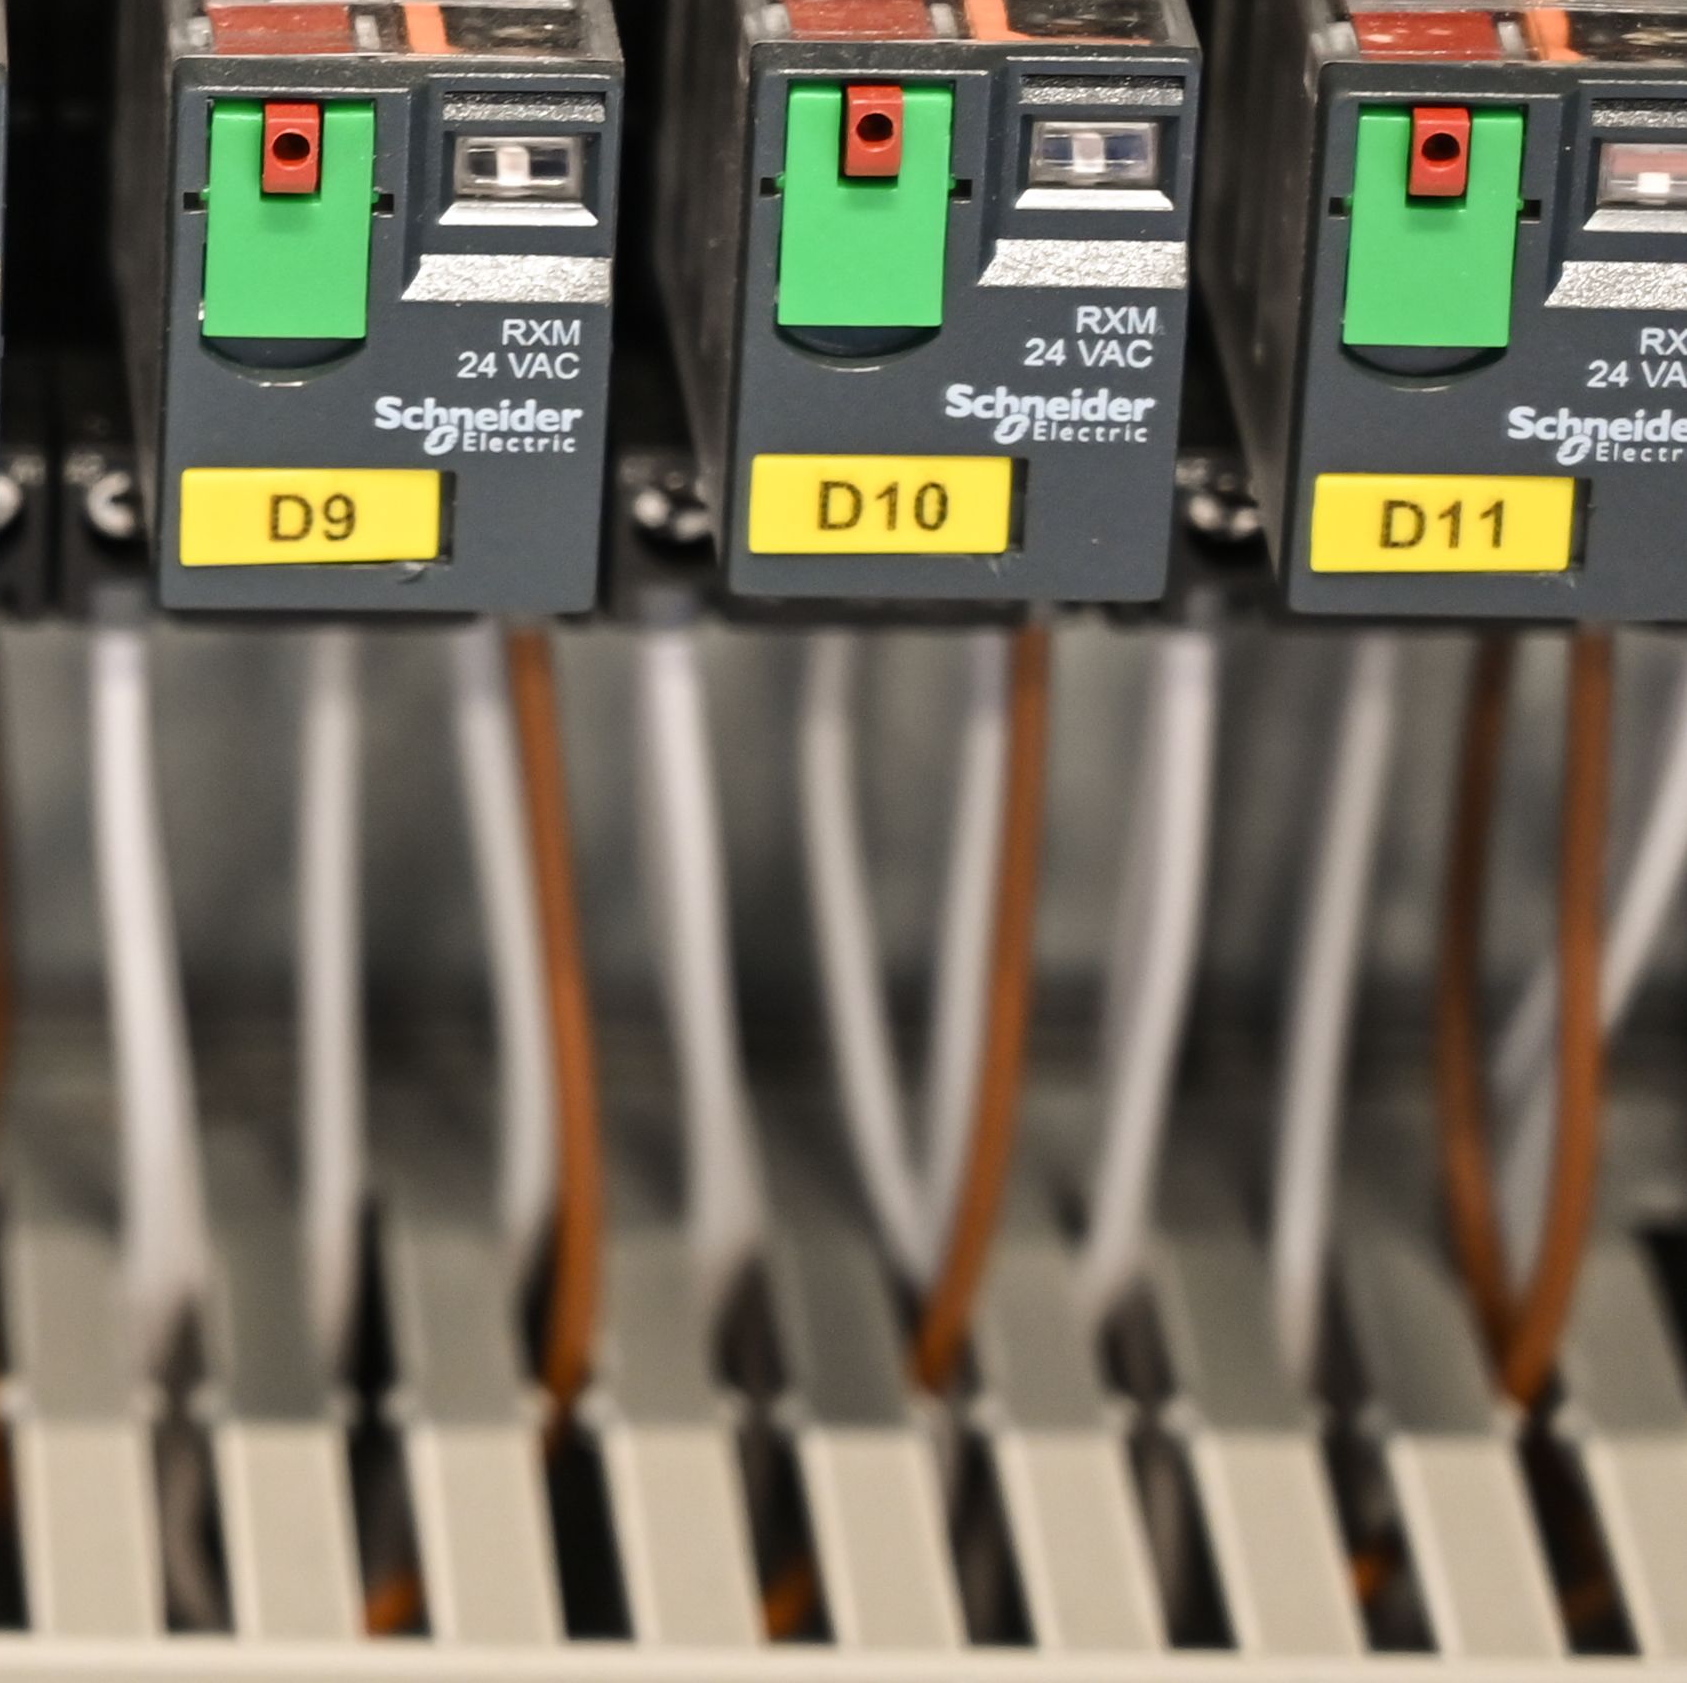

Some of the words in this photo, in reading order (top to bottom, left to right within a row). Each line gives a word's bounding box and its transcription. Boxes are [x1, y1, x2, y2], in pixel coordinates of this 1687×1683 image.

[502, 319, 581, 345] RXM
[1076, 306, 1156, 334] RXM
[1024, 338, 1066, 366] 24
[1077, 339, 1153, 368] VAC
[1640, 328, 1687, 355] RX
[457, 351, 497, 378] 24
[507, 352, 579, 379] VAC
[1587, 360, 1629, 388] 24
[1641, 361, 1687, 388] VA
[375, 396, 583, 433] Schneider
[945, 384, 1156, 423] Schneider
[1033, 421, 1147, 442] Electric
[1507, 406, 1687, 444] Schneide
[463, 430, 575, 453] Electric
[1590, 441, 1687, 462] Electr
[269, 493, 356, 542] D9
[818, 481, 948, 531] D10
[1379, 500, 1504, 549] D11
